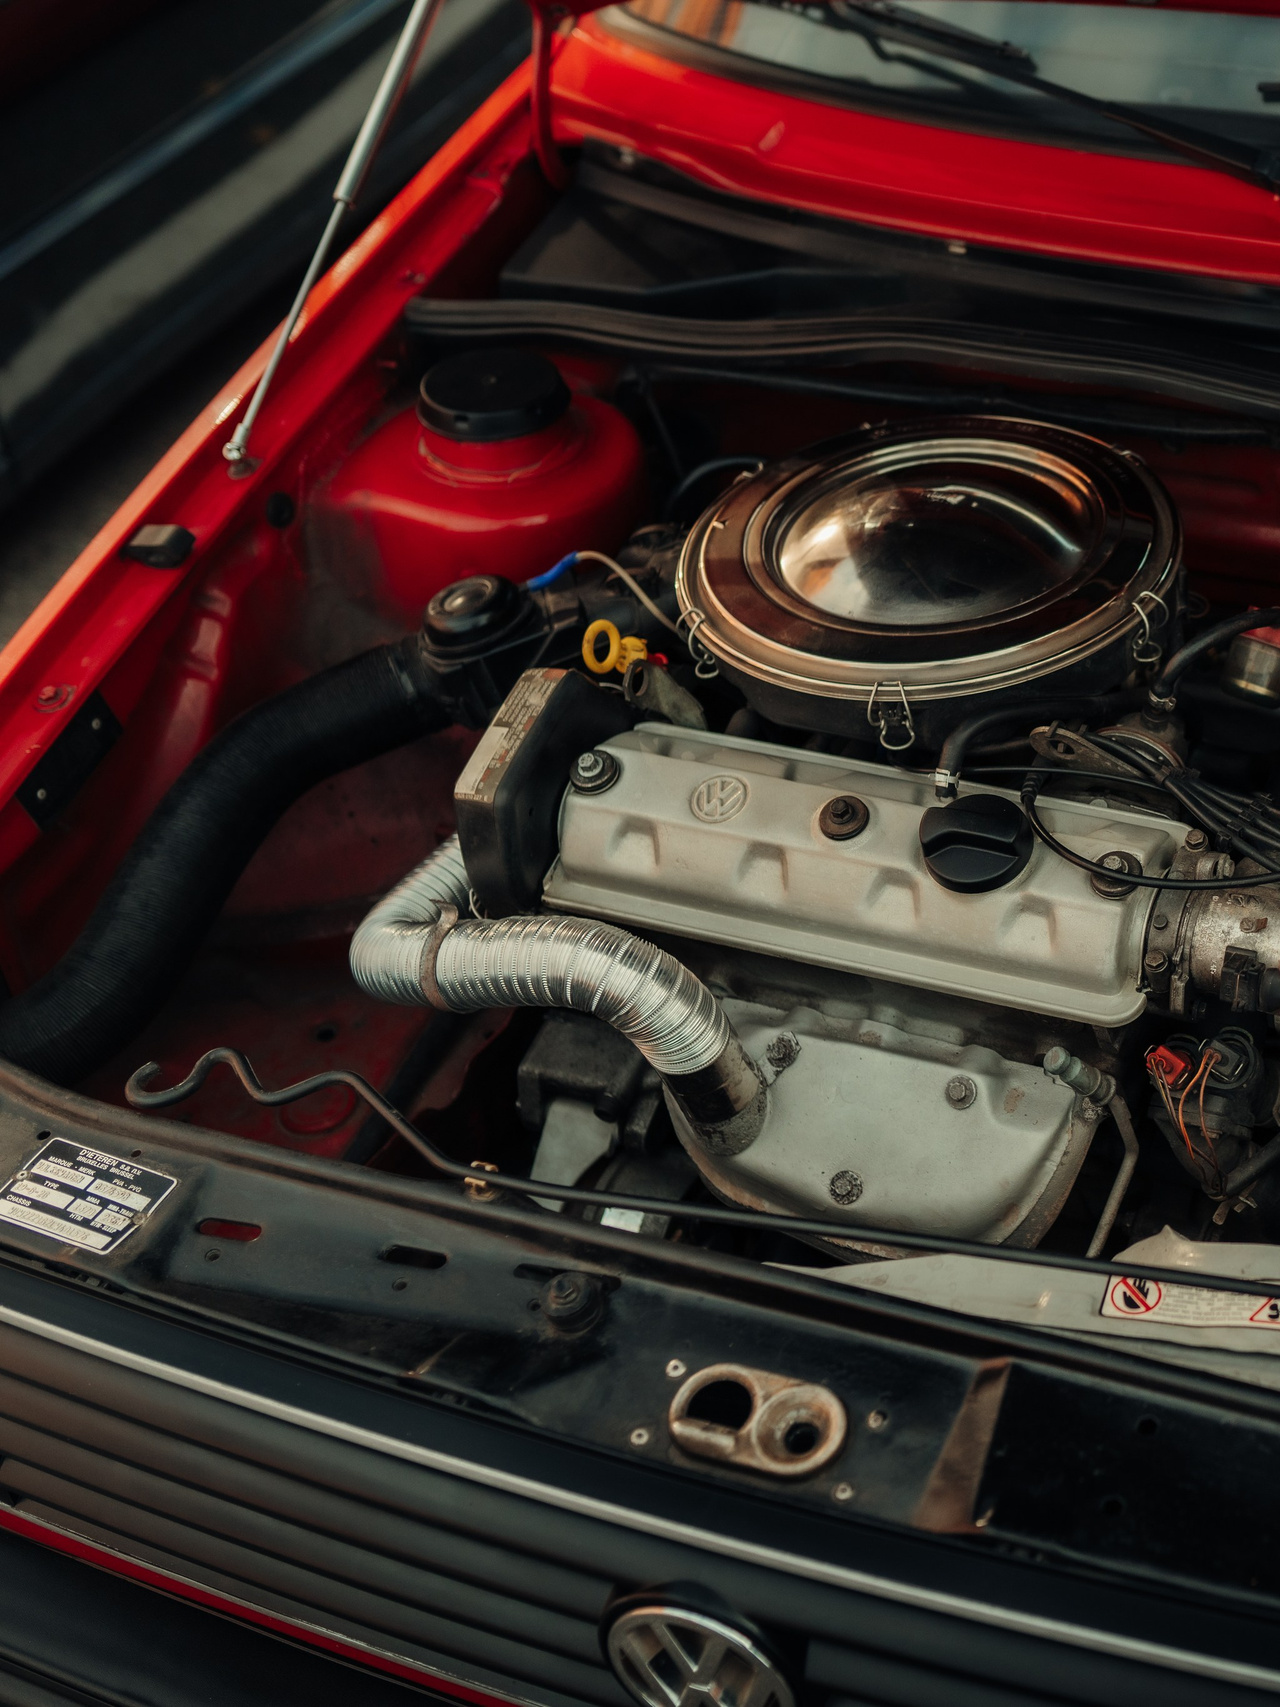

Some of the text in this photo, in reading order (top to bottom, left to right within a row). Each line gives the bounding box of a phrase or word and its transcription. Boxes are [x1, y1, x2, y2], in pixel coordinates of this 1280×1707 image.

[48, 1156, 96, 1176] MARQUE MERK
[79, 1149, 119, 1166] D'IETEREN
[76, 1156, 135, 1180] BRUXELLES BRUSSEL
[44, 1180, 60, 1190] TYPE
[6, 1194, 32, 1206] CHASSIS
